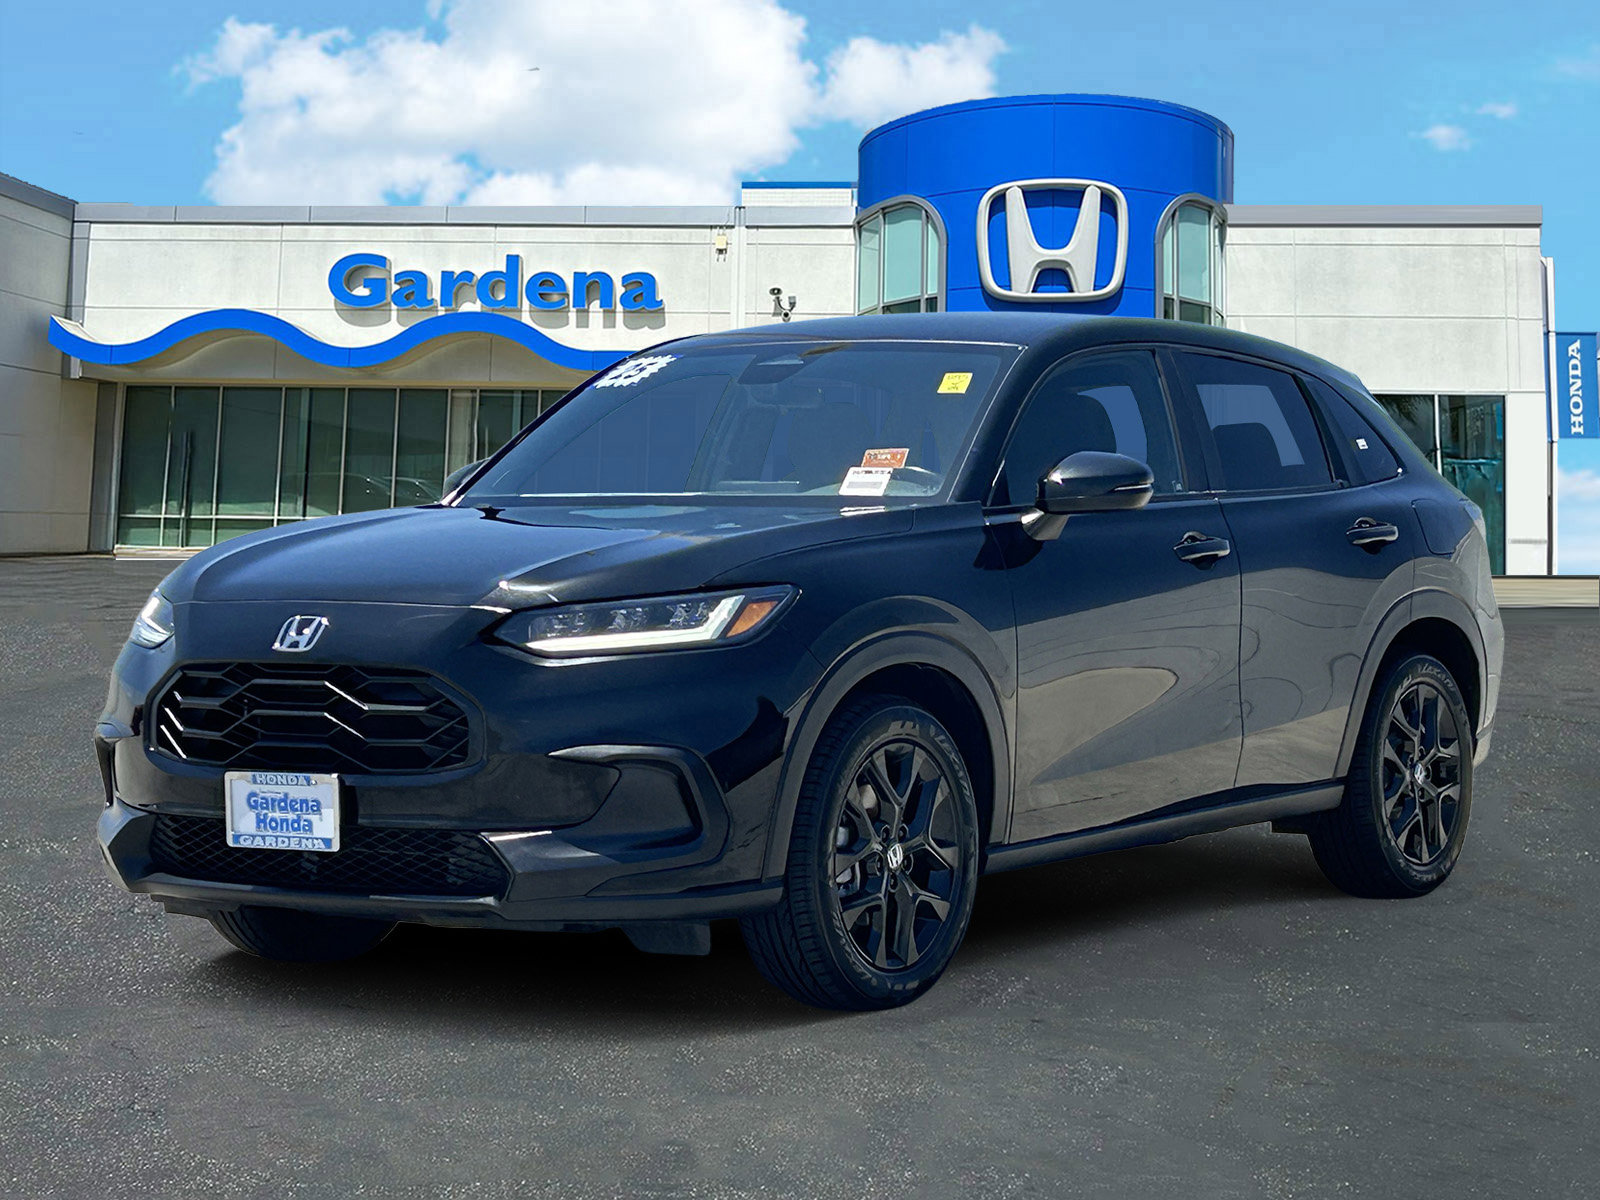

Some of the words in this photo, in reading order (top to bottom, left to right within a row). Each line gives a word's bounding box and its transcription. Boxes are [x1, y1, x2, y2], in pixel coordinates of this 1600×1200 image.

[328, 252, 663, 310] Gardena
[1568, 339, 1584, 435] HONDA
[256, 774, 308, 786] HONDA
[246, 792, 322, 815] Gardena
[255, 812, 313, 834] Honda
[239, 835, 326, 849] GARDENA
